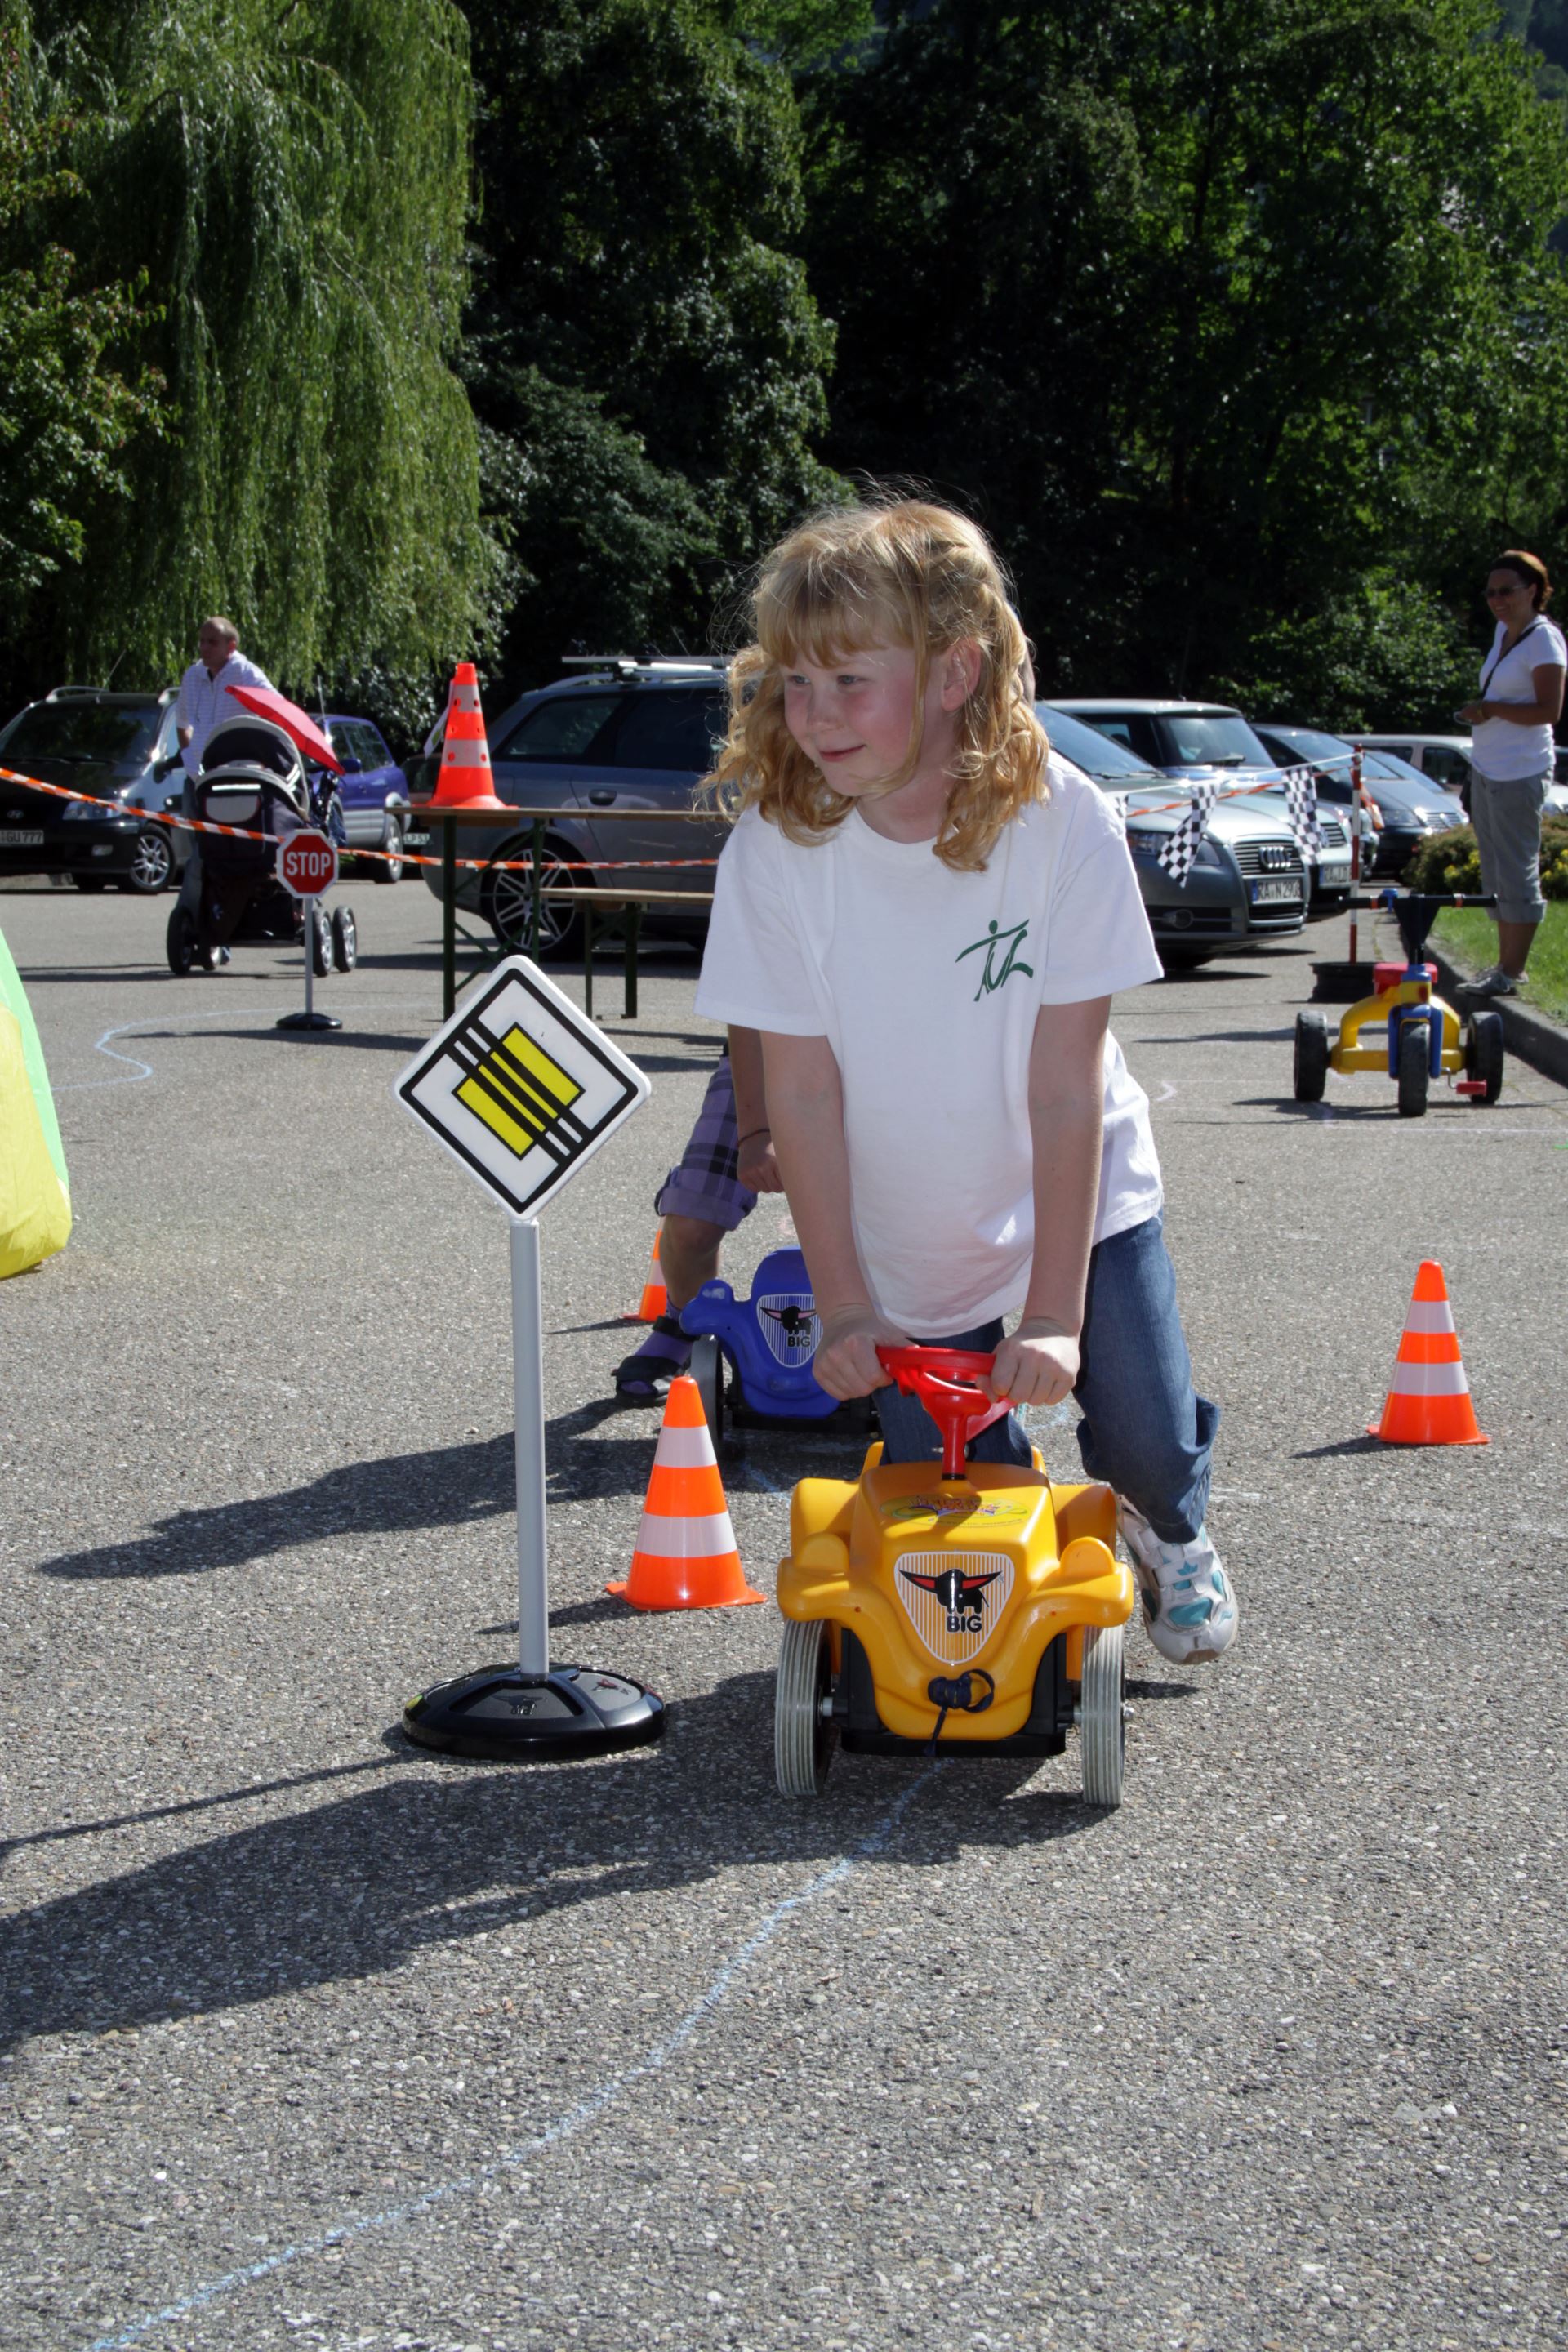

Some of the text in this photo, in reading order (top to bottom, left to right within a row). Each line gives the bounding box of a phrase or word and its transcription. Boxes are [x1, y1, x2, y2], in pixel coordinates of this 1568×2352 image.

[287, 851, 331, 876] STOP
[1258, 881, 1271, 900] RA
[787, 1336, 811, 1348] BIG
[947, 1615, 982, 1633] BIG
